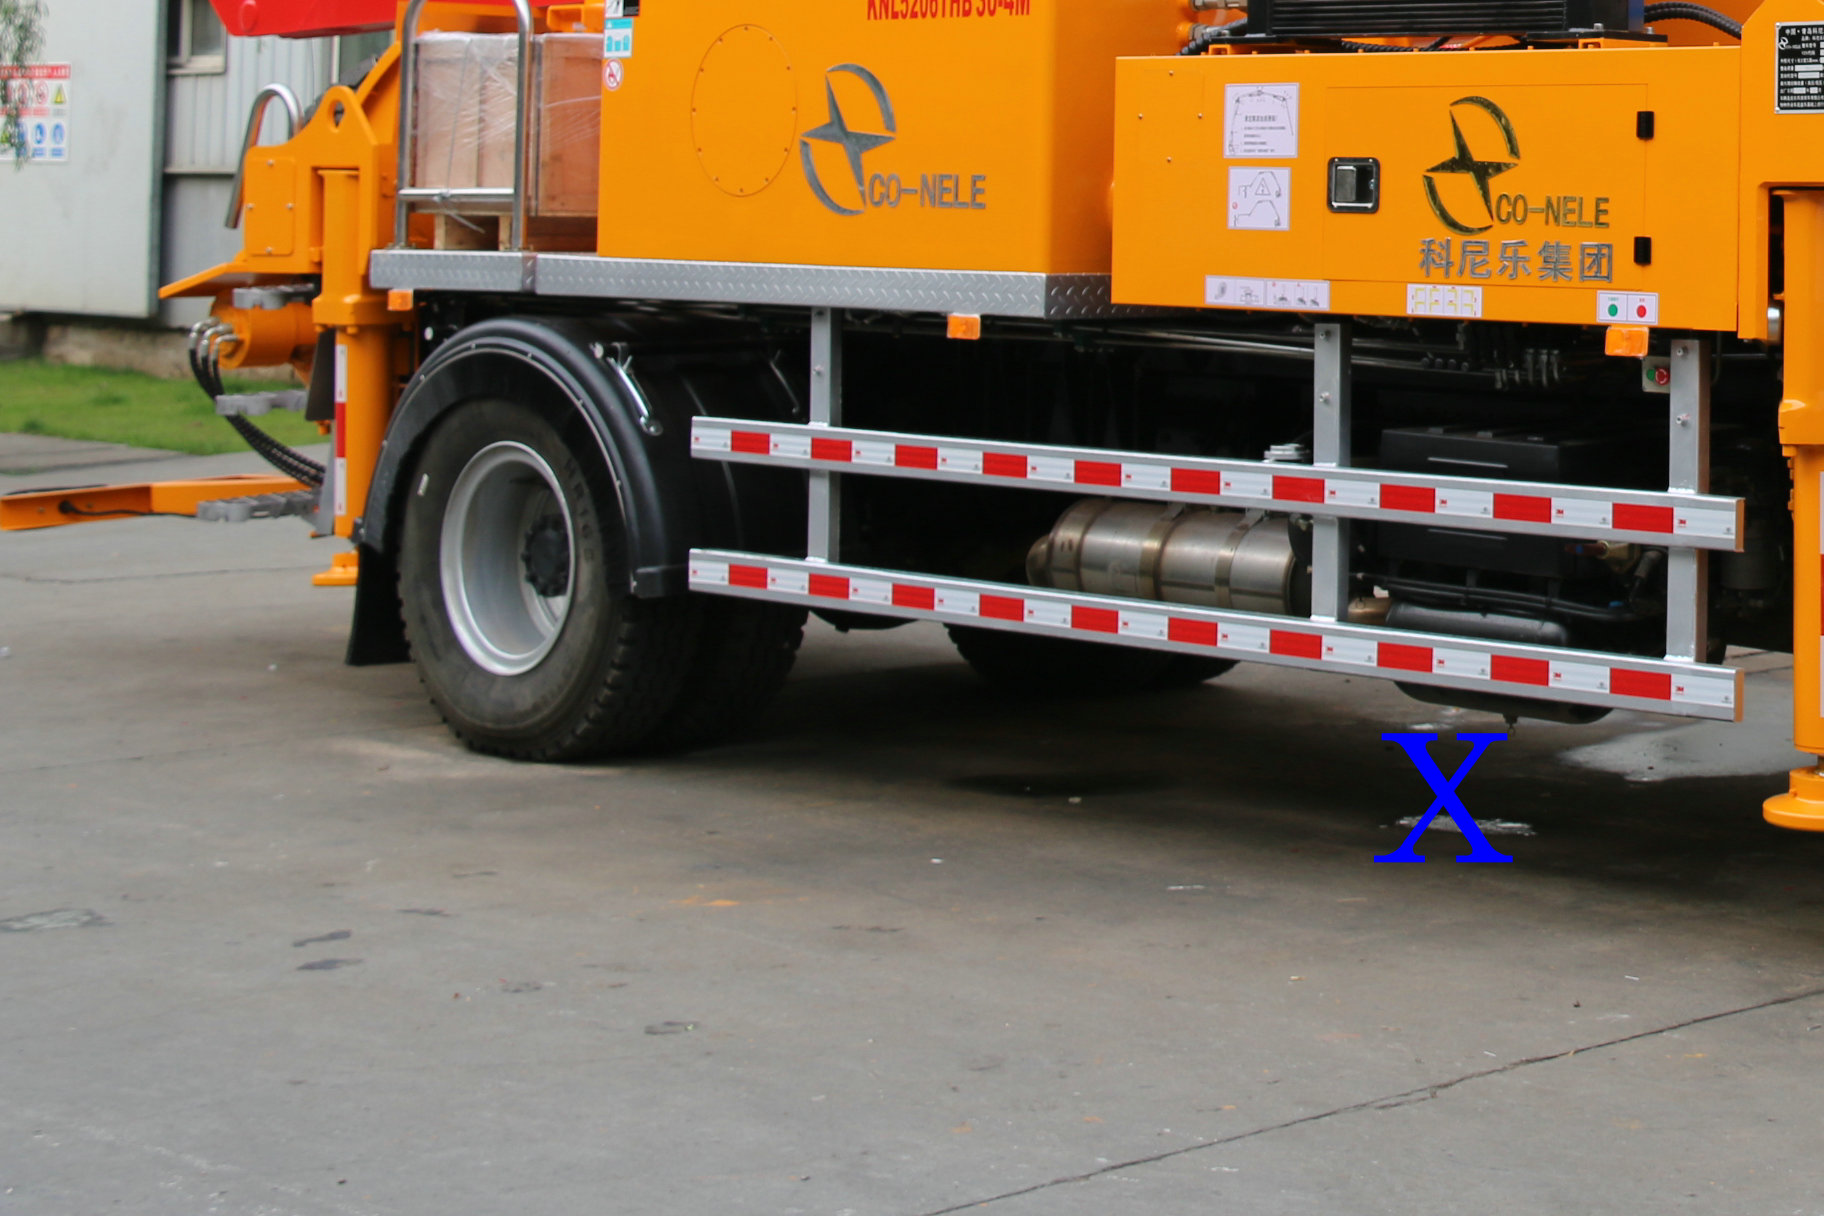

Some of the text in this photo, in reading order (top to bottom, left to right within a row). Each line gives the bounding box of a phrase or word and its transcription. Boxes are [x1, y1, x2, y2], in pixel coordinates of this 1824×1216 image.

[868, 172, 987, 210] CO-NELE
[1496, 192, 1611, 229] CO-NELE
[1419, 237, 1614, 283] 科尼乐集团
